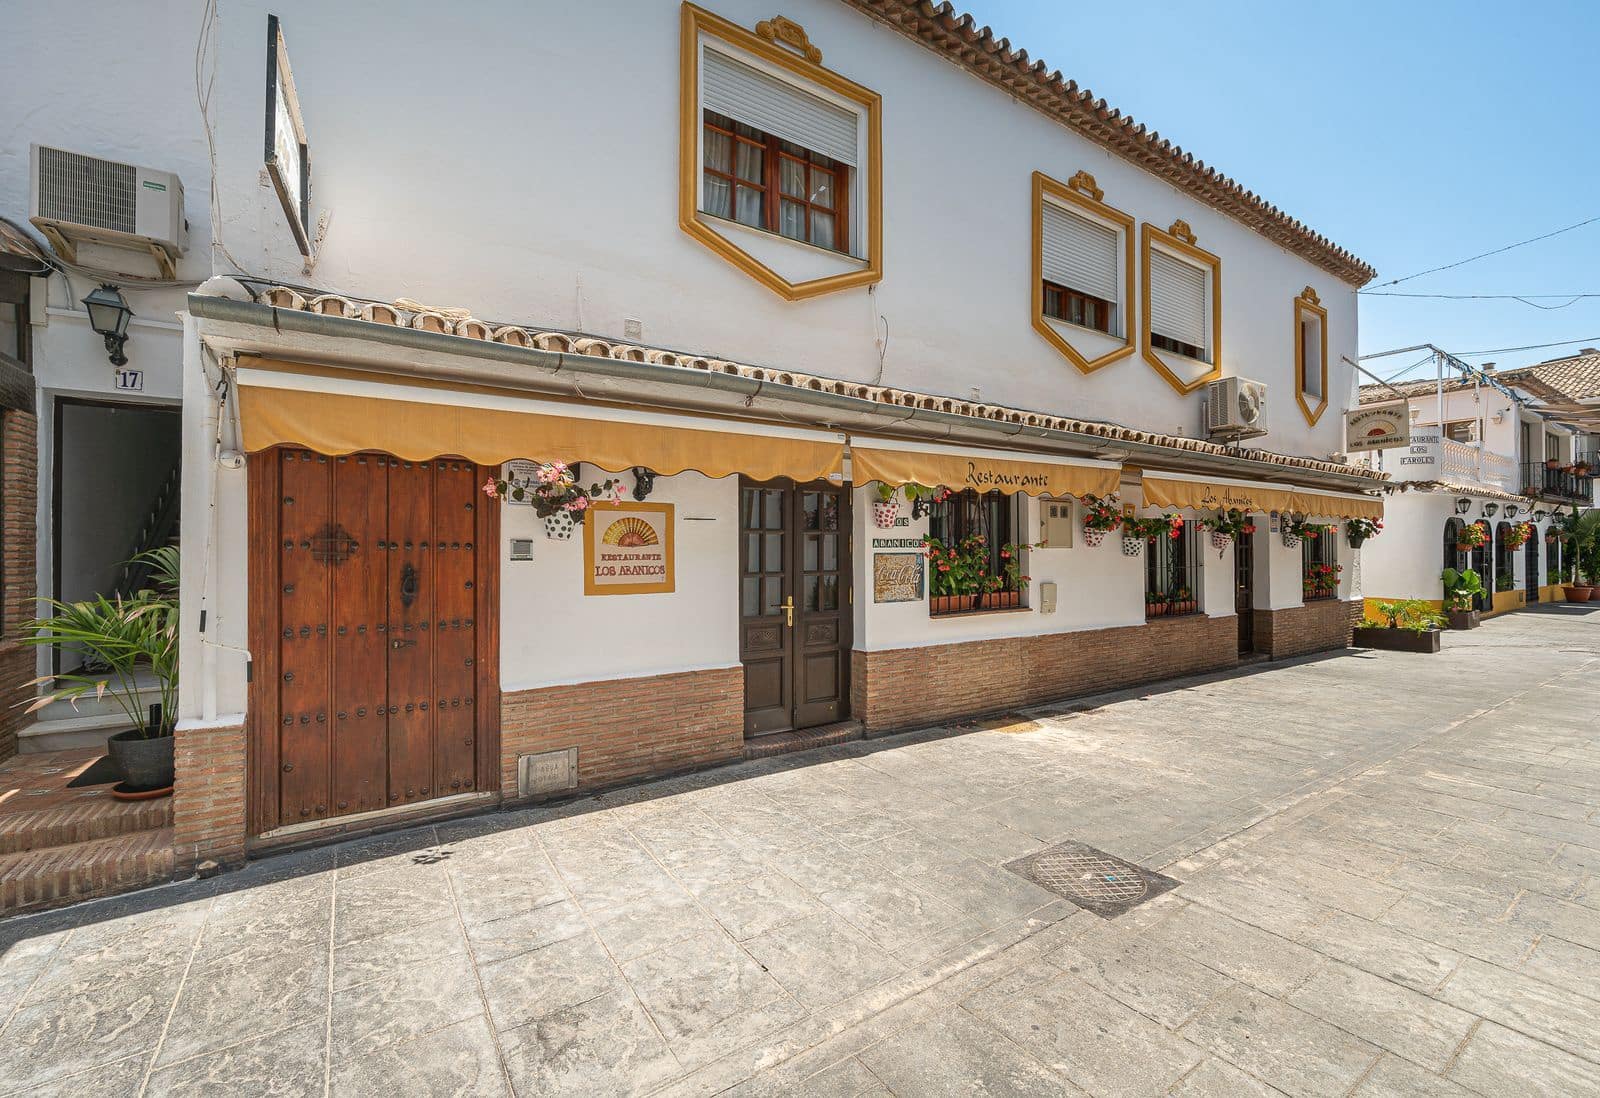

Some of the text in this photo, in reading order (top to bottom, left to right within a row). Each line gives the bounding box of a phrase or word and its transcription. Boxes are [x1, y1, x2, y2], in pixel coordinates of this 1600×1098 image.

[120, 371, 139, 388] 17
[965, 461, 1049, 487] Restaurante
[895, 518, 909, 527] OS
[601, 553, 662, 561] RESTAURANTE
[595, 565, 666, 577] LOS ABANICOS
